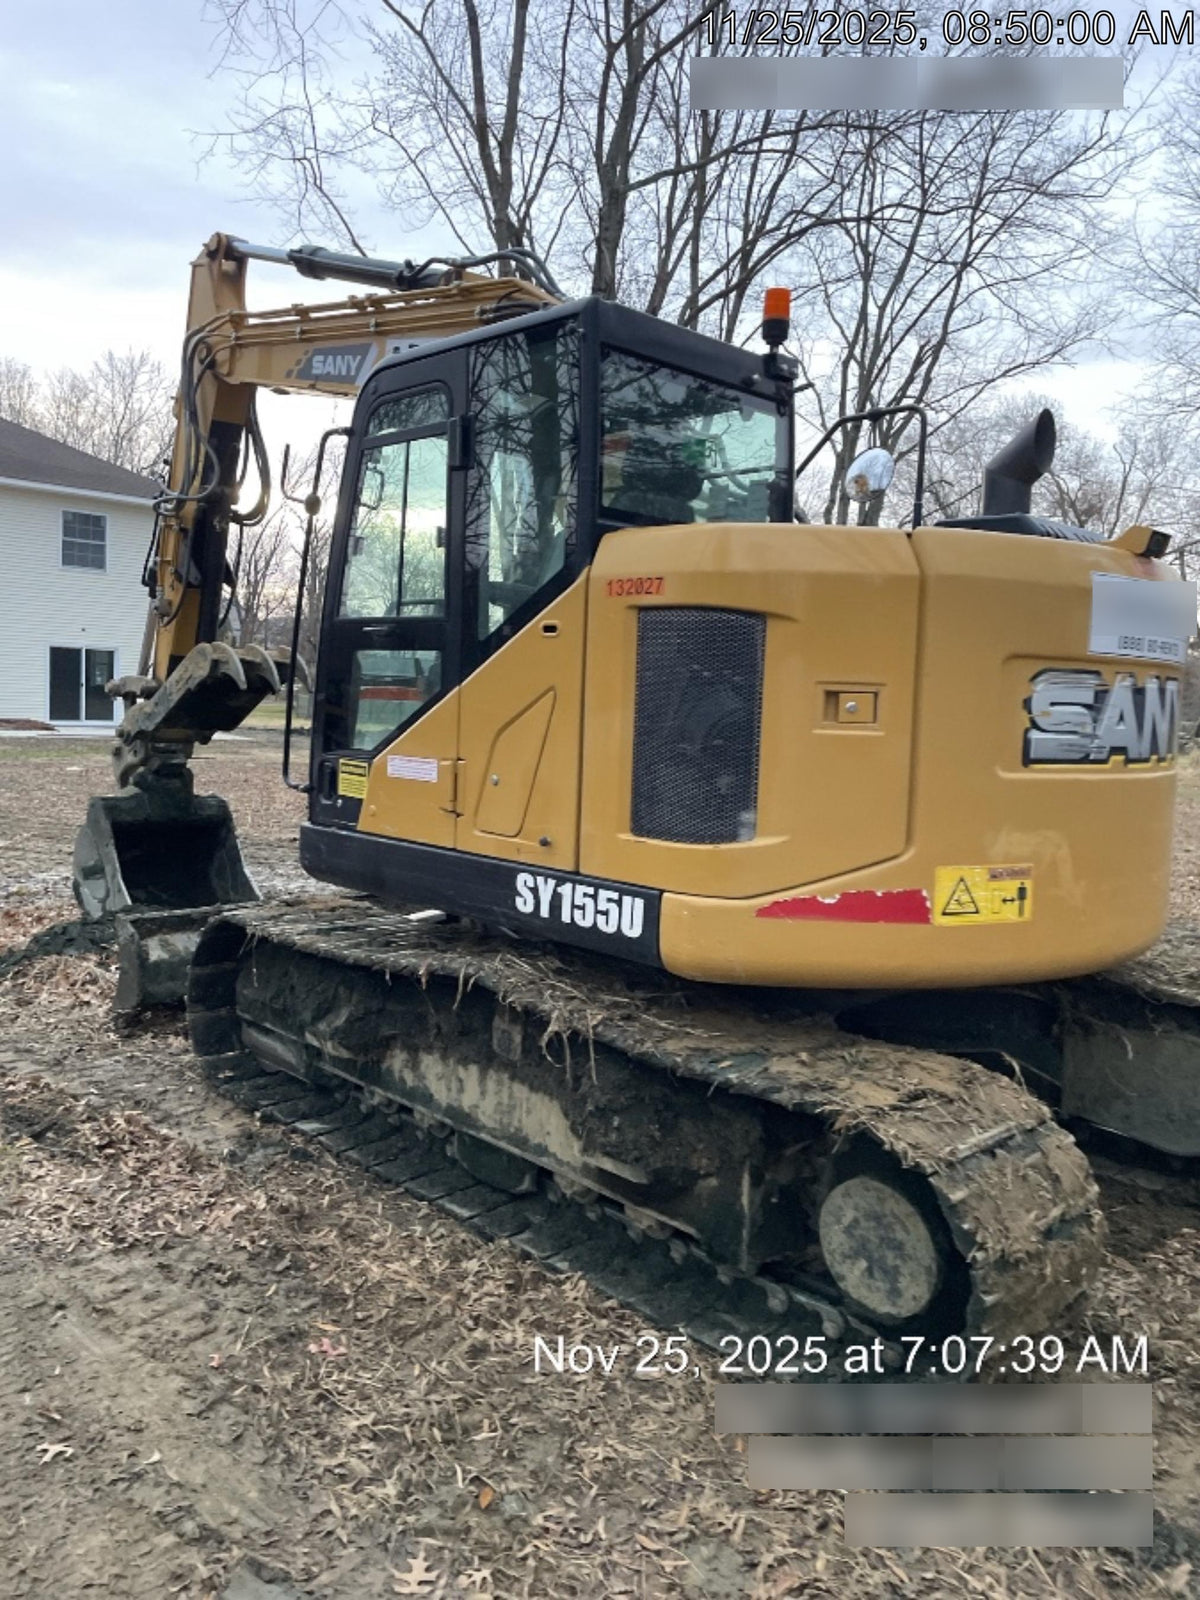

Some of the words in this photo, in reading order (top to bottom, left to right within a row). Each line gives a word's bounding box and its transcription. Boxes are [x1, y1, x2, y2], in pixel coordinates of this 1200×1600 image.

[311, 354, 362, 376] SANY
[607, 576, 664, 597] 132027
[1023, 668, 1179, 767] SAN
[515, 872, 645, 938] SY155U
